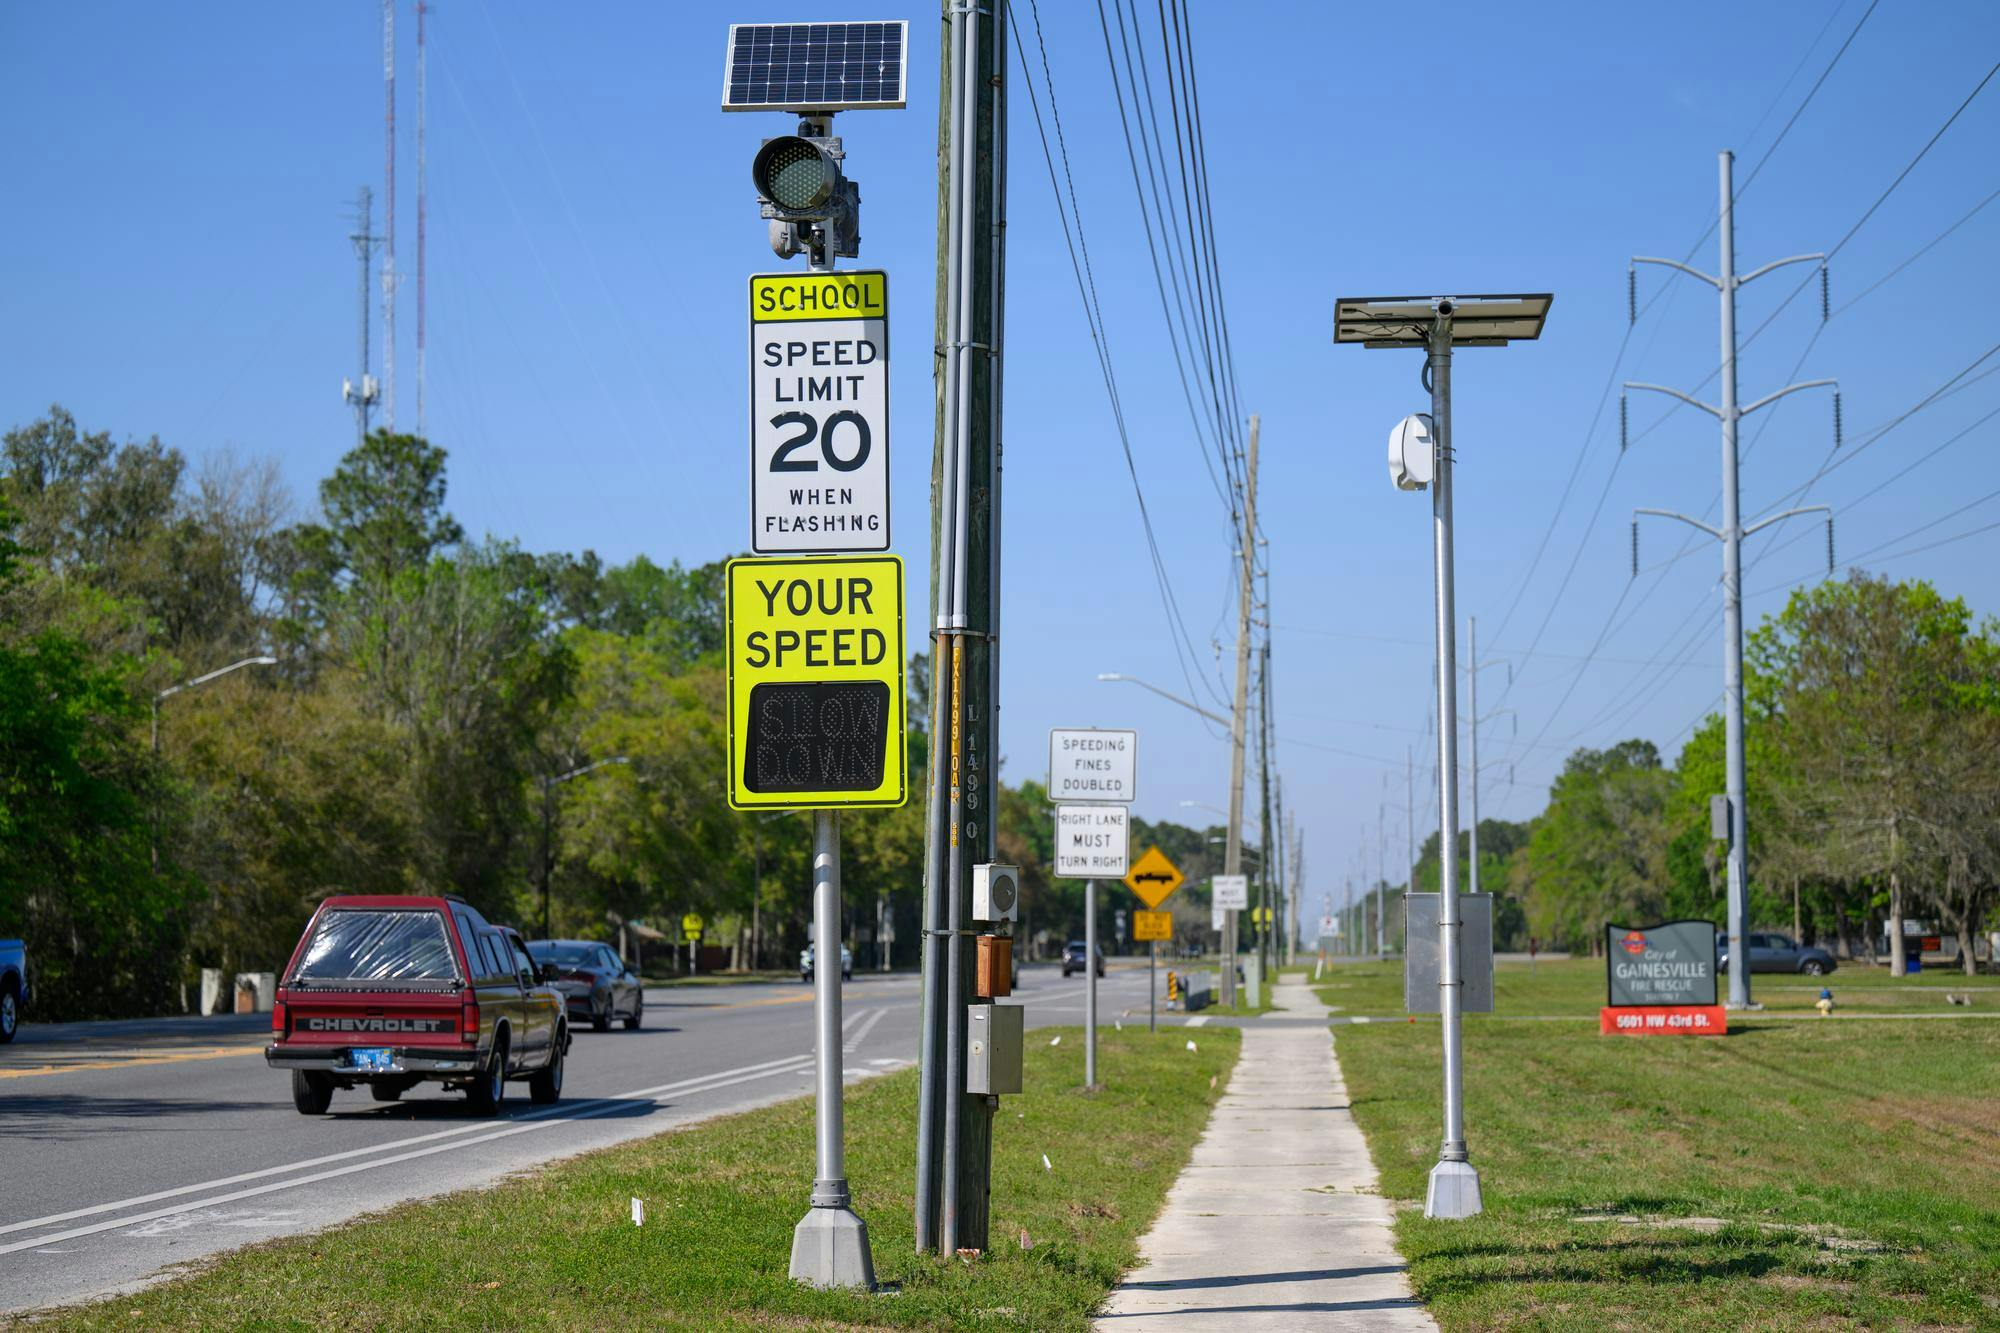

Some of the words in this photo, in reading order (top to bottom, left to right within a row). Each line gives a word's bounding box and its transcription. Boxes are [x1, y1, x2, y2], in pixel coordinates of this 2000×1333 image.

[759, 283, 880, 312] SCHOOL
[763, 340, 877, 367] SPEED
[775, 376, 865, 402] LIMIT
[769, 410, 872, 473] 20
[789, 488, 852, 505] WHEN
[766, 514, 879, 532] FLASHING
[755, 577, 873, 617] YOUR
[745, 628, 887, 668] SPEED
[760, 697, 881, 740] SLOW
[1063, 739, 1126, 751] SPEEDING
[757, 743, 877, 785] DOWN
[1075, 759, 1111, 771] FINES
[1063, 779, 1122, 791] DOUBLED
[1061, 814, 1092, 825] RIGHT
[1096, 814, 1123, 825] LANE
[1073, 834, 1111, 848] MUST
[1060, 856, 1087, 867] TURN
[1092, 856, 1123, 867] RIGHT
[1645, 950, 1664, 961] City
[1665, 949, 1677, 960] of
[1616, 962, 1707, 979] GAINESVILLE
[1630, 980, 1651, 991] FIRE
[1655, 979, 1693, 991] RESCUE
[309, 1018, 440, 1032] CHEVROLET
[1646, 1015, 1666, 1028] NW
[1668, 1014, 1693, 1027] 43rd
